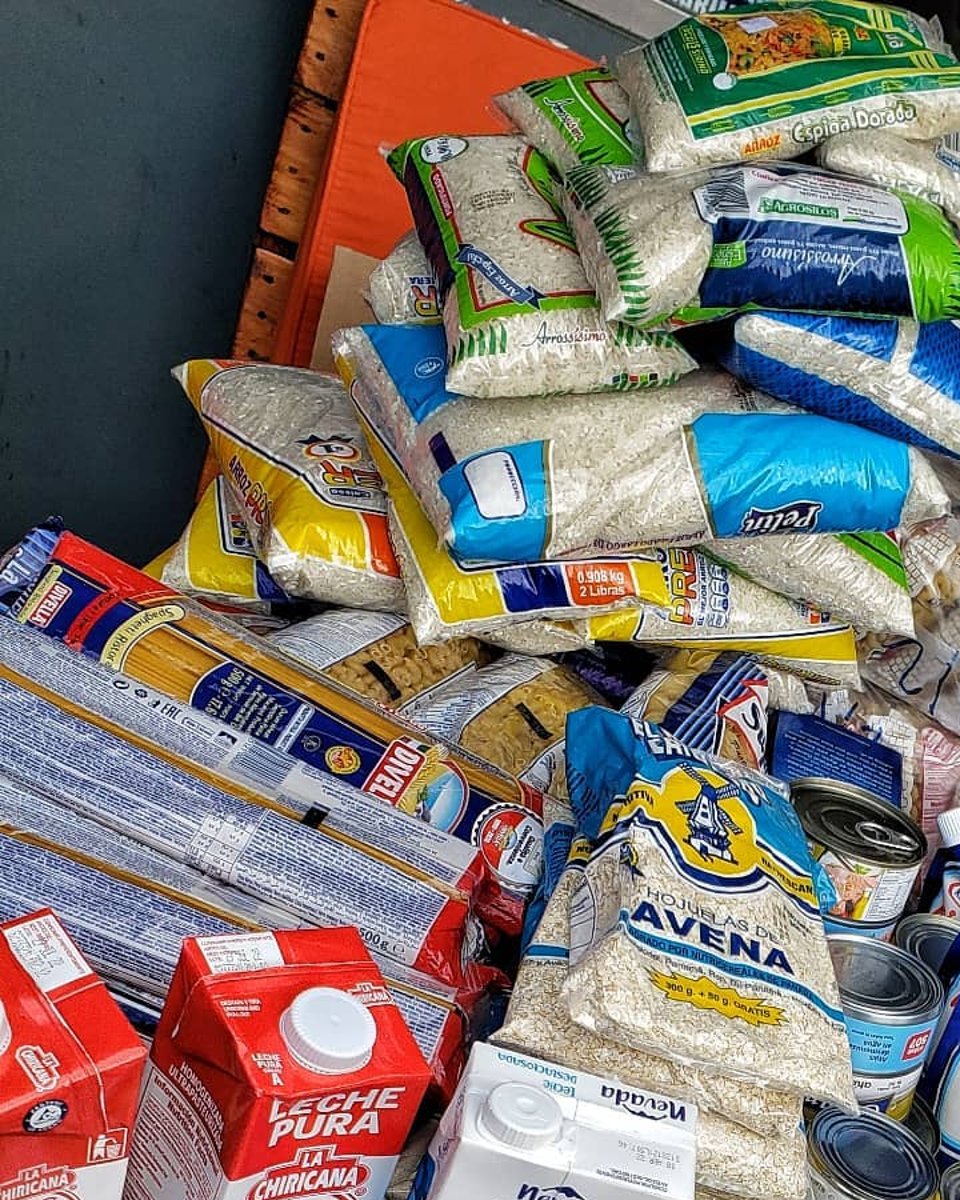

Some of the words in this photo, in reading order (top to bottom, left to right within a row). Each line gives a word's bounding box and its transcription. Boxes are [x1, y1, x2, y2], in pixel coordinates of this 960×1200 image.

[791, 117, 851, 144] Espiga
[851, 103, 917, 130] Dorada
[772, 200, 839, 219] AGROSILOS
[577, 571, 608, 584] 0.908
[609, 571, 625, 586] kg
[580, 586, 587, 597] 2
[589, 584, 625, 597] Libras
[29, 582, 68, 627] DIVELLA
[369, 746, 421, 804] DIVEL
[645, 884, 749, 934] HOJUELAS
[632, 898, 795, 976] AVENA
[731, 998, 772, 1019] GRATIS
[269, 1087, 406, 1123] LECHE
[268, 1110, 379, 1147] PURA
[24, 1167, 40, 1181] LA
[300, 1150, 323, 1168] LA
[0, 1172, 69, 1200] HIRICANA
[253, 1166, 360, 1200] CHIRICANA
